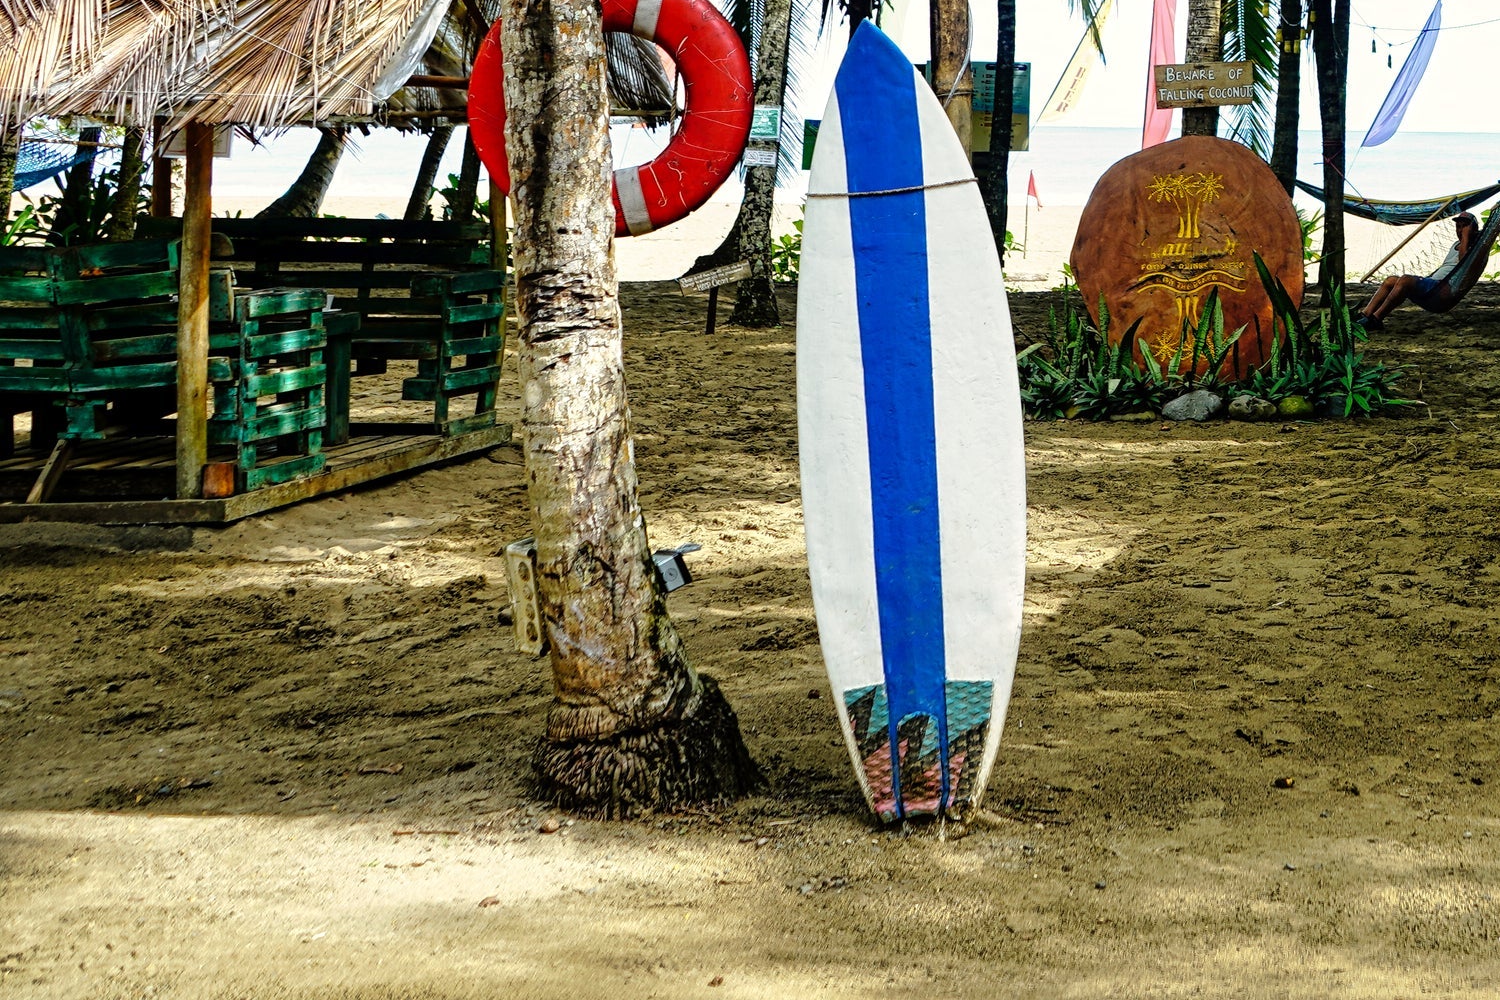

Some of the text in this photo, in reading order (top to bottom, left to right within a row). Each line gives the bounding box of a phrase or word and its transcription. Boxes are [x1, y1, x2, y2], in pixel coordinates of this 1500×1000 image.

[1166, 67, 1243, 83] BEWARE OF
[1208, 85, 1254, 99] COCONUTS
